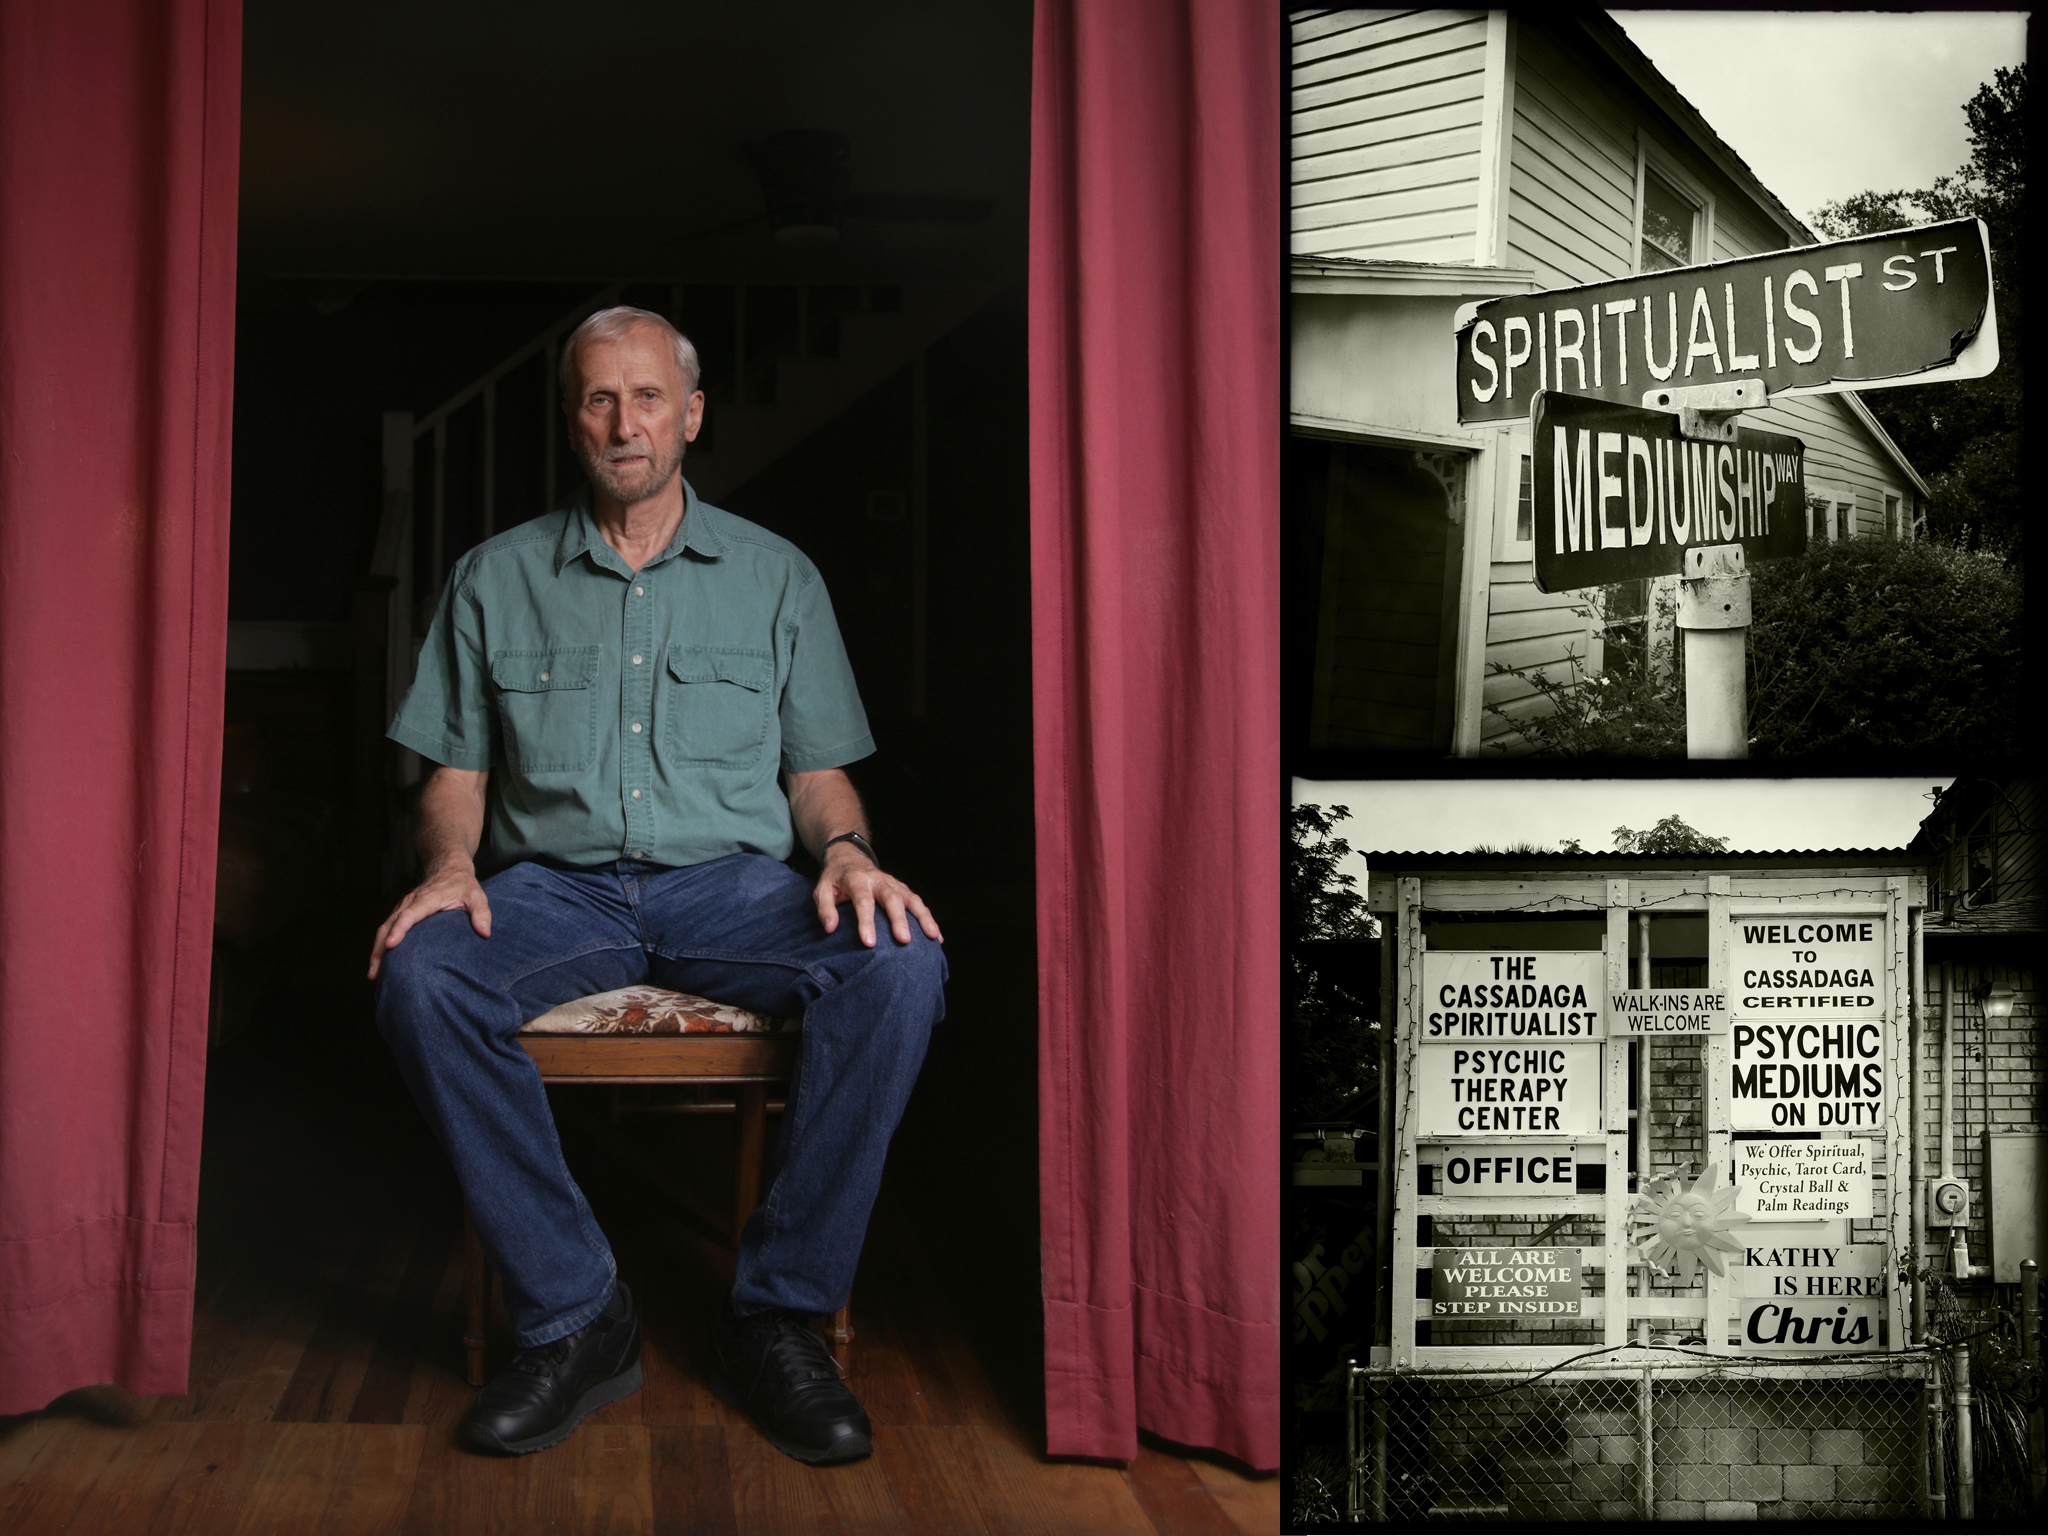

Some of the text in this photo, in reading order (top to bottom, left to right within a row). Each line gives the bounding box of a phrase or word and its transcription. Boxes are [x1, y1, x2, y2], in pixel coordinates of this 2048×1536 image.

[1471, 246, 1958, 403] SPIRITUALIST ST
[1553, 425, 1799, 555] MEDIUMSHIP WAY
[1743, 923, 1873, 944] WELCOME
[1792, 950, 1817, 963] TO
[1490, 957, 1536, 980] THE
[1743, 969, 1875, 989] CASSADAGA
[1439, 984, 1588, 1008] CASSADAGA
[1612, 995, 1725, 1012] WALK-INS ARE
[1742, 996, 1875, 1008] CERTIFIED
[1428, 1012, 1597, 1036] SPIRITUALIST
[1628, 1015, 1711, 1031] WELCOME
[1733, 1024, 1880, 1059] PSYCHIC
[1454, 1050, 1566, 1074] PSYCHIC
[1451, 1078, 1568, 1102] THERAPY
[1732, 1063, 1882, 1099] MEDIUMS
[1458, 1107, 1560, 1130] CENTER
[1771, 1102, 1881, 1126] ON DUTY
[1745, 1144, 1865, 1162] We Offer Spiritual,
[1446, 1157, 1573, 1184] OFFICE
[1741, 1161, 1867, 1179] Psychic, Tarot Card,
[1759, 1180, 1849, 1198] Crystal Ball &
[1756, 1198, 1849, 1214] Palm Readings
[1459, 1251, 1555, 1266] ALL ARE
[1745, 1247, 1840, 1267] KATHY
[1292, 1224, 1375, 1345] epper
[1443, 1267, 1572, 1284] WELCOME
[1464, 1285, 1549, 1298] PLEASE
[1774, 1276, 1881, 1296] IS HERE
[1435, 1301, 1579, 1315] STEP INSIDE
[1747, 1303, 1874, 1345] Chris
